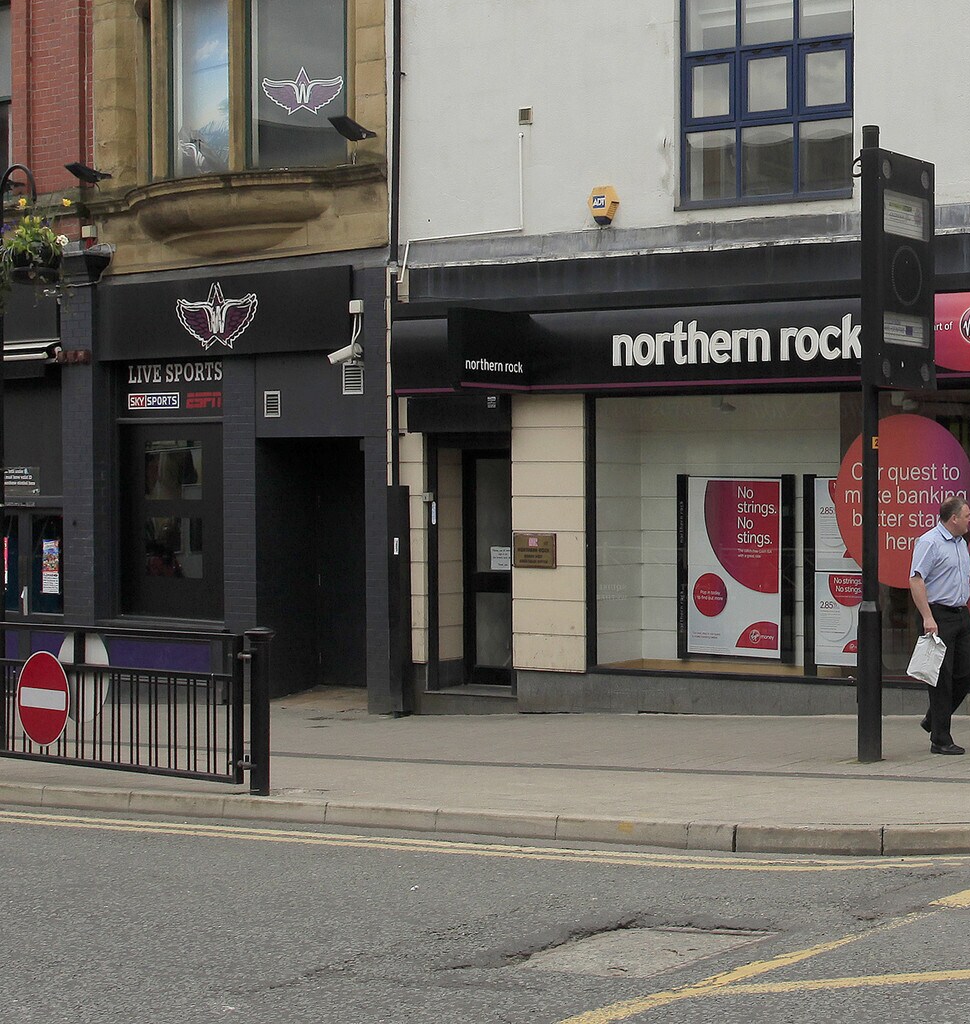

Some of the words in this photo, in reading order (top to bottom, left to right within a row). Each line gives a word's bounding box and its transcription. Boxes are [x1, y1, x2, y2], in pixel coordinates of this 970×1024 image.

[593, 197, 606, 207] ADT
[944, 321, 954, 331] of
[612, 320, 772, 367] northern
[780, 313, 862, 362] rock
[128, 364, 161, 384] LIVE
[165, 361, 223, 383] SPORTS
[465, 358, 504, 372] northern
[504, 361, 523, 374] rock
[130, 396, 145, 407] SKY
[146, 394, 178, 406] SPORTS
[186, 392, 222, 408] ESPN
[851, 462, 884, 481] Or
[887, 463, 938, 486] quest
[941, 463, 960, 481] to
[737, 486, 754, 499] No
[844, 489, 892, 504] me
[737, 501, 777, 517] strings.
[737, 516, 754, 529] No
[852, 508, 904, 527] bter
[737, 531, 773, 547] stings.
[835, 585, 844, 593] No
